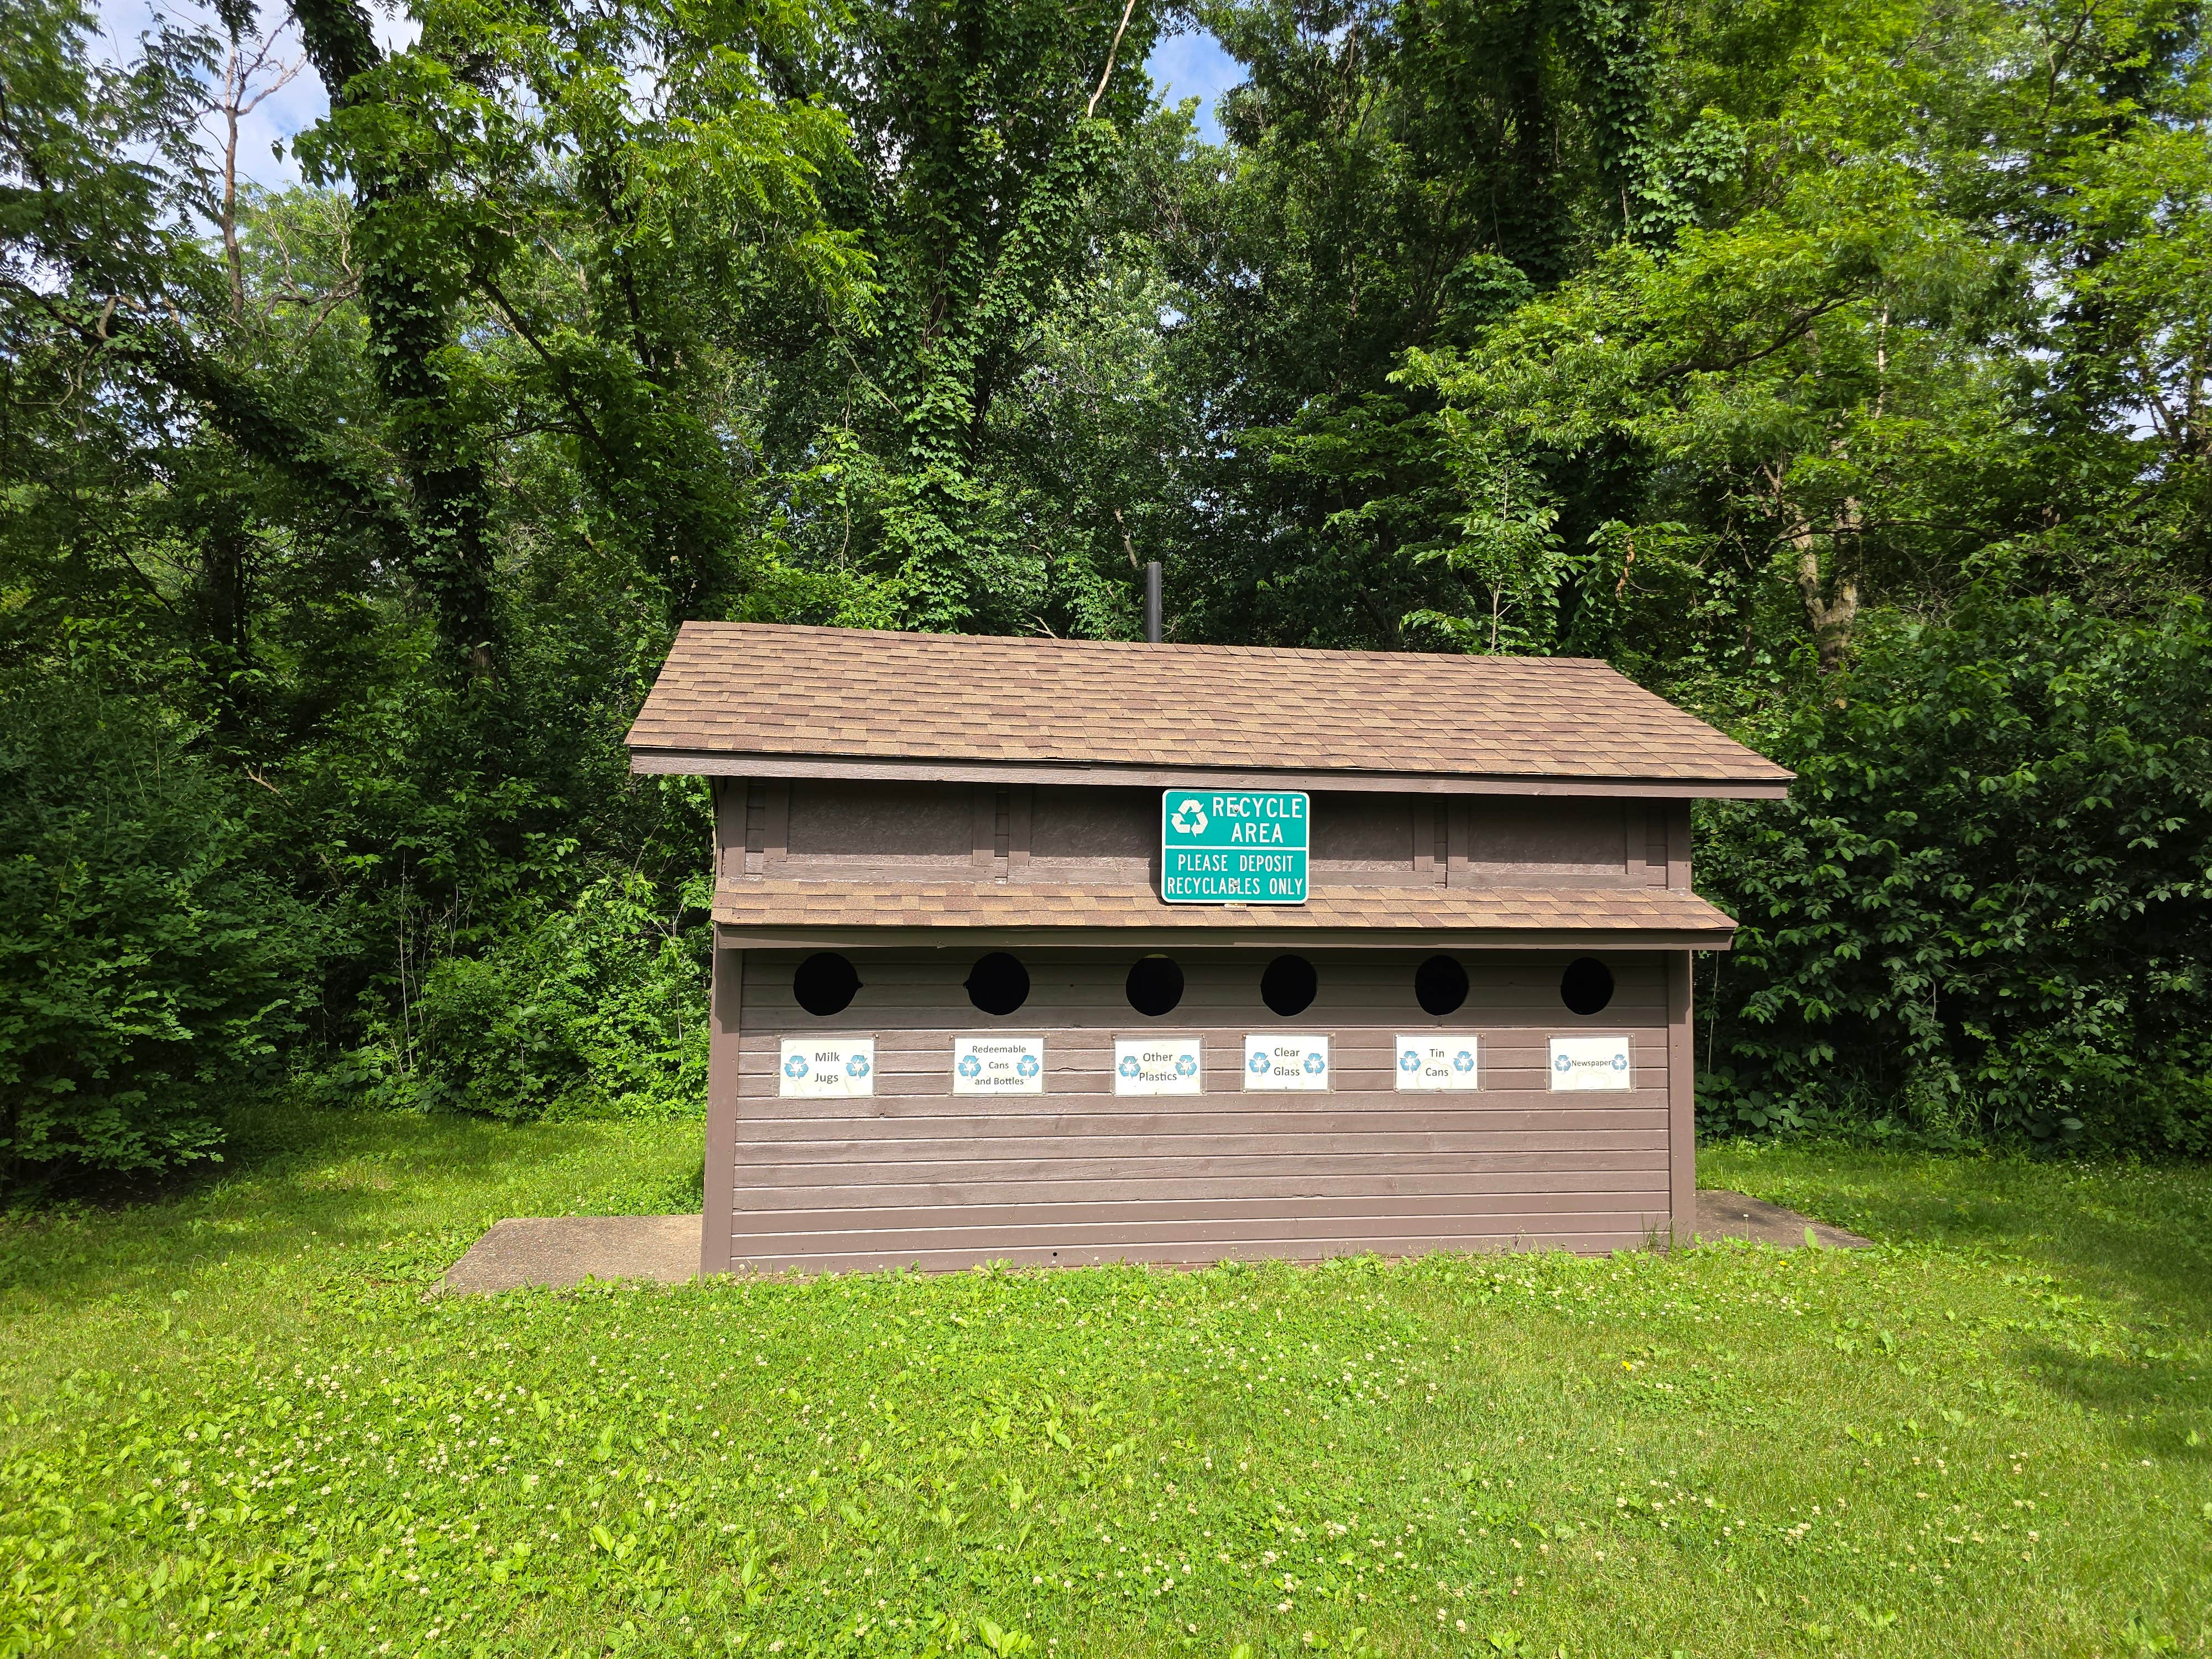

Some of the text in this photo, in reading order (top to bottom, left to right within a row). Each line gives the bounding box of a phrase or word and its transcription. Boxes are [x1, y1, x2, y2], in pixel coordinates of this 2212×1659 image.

[1213, 796, 1303, 818] RECYCLE
[1230, 822, 1284, 843] AREA
[1178, 854, 1293, 872] PLEASE DEPOSIT
[1167, 877, 1303, 895] RECYCLABLES ONLY
[815, 1052, 840, 1062] Milk
[1142, 1052, 1173, 1061] Other
[1274, 1047, 1300, 1057] Clear
[1429, 1048, 1444, 1057] Tin
[1139, 1071, 1177, 1081] Plastics
[1274, 1066, 1300, 1076] Glass
[1426, 1067, 1449, 1076] Cans
[814, 1073, 838, 1084] Jugs
